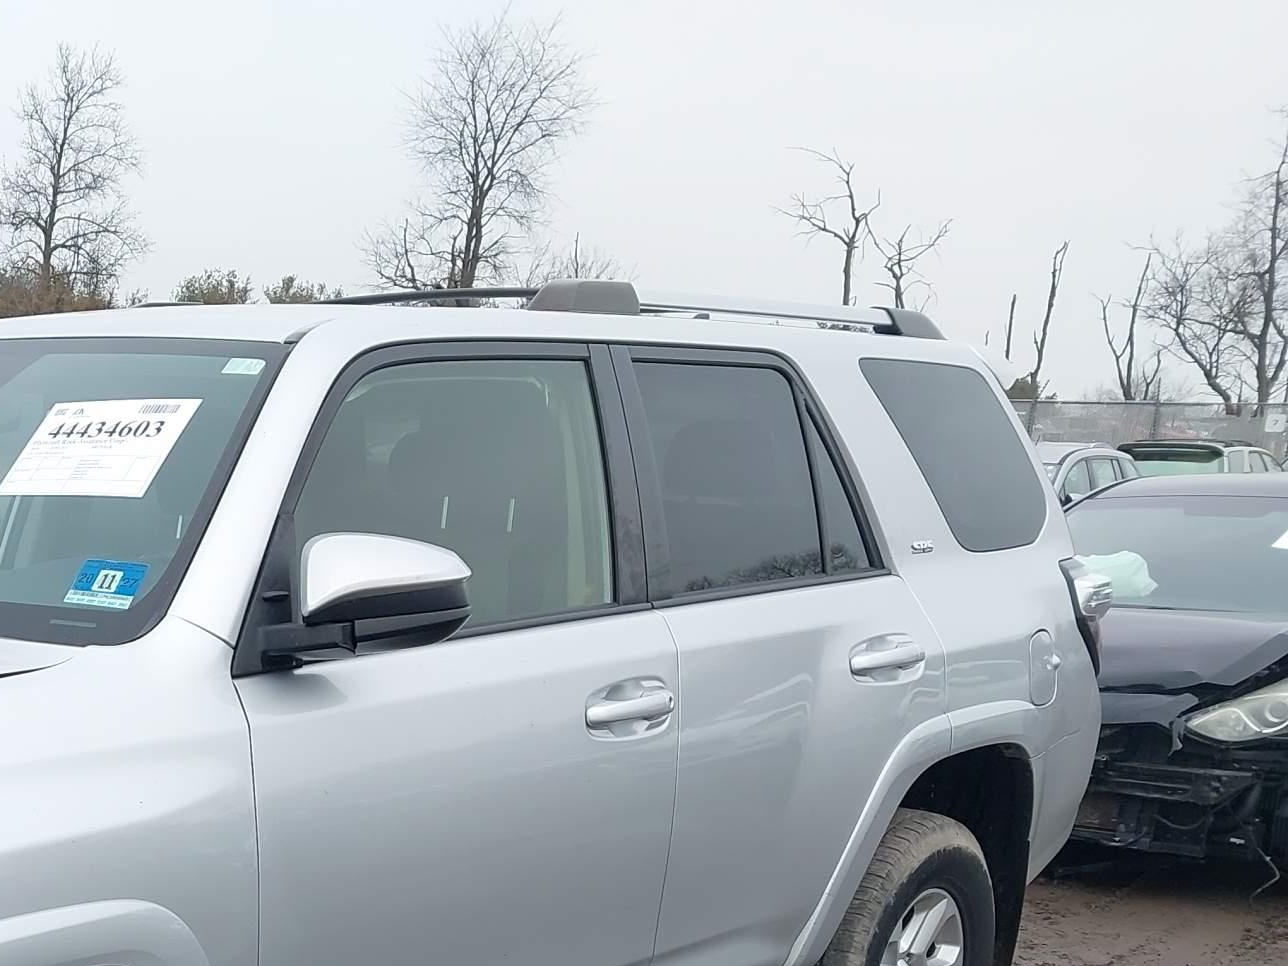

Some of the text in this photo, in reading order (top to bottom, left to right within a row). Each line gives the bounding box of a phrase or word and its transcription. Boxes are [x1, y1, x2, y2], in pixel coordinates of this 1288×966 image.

[48, 420, 165, 439] 44434603
[78, 573, 95, 584] 20
[97, 572, 117, 590] 11
